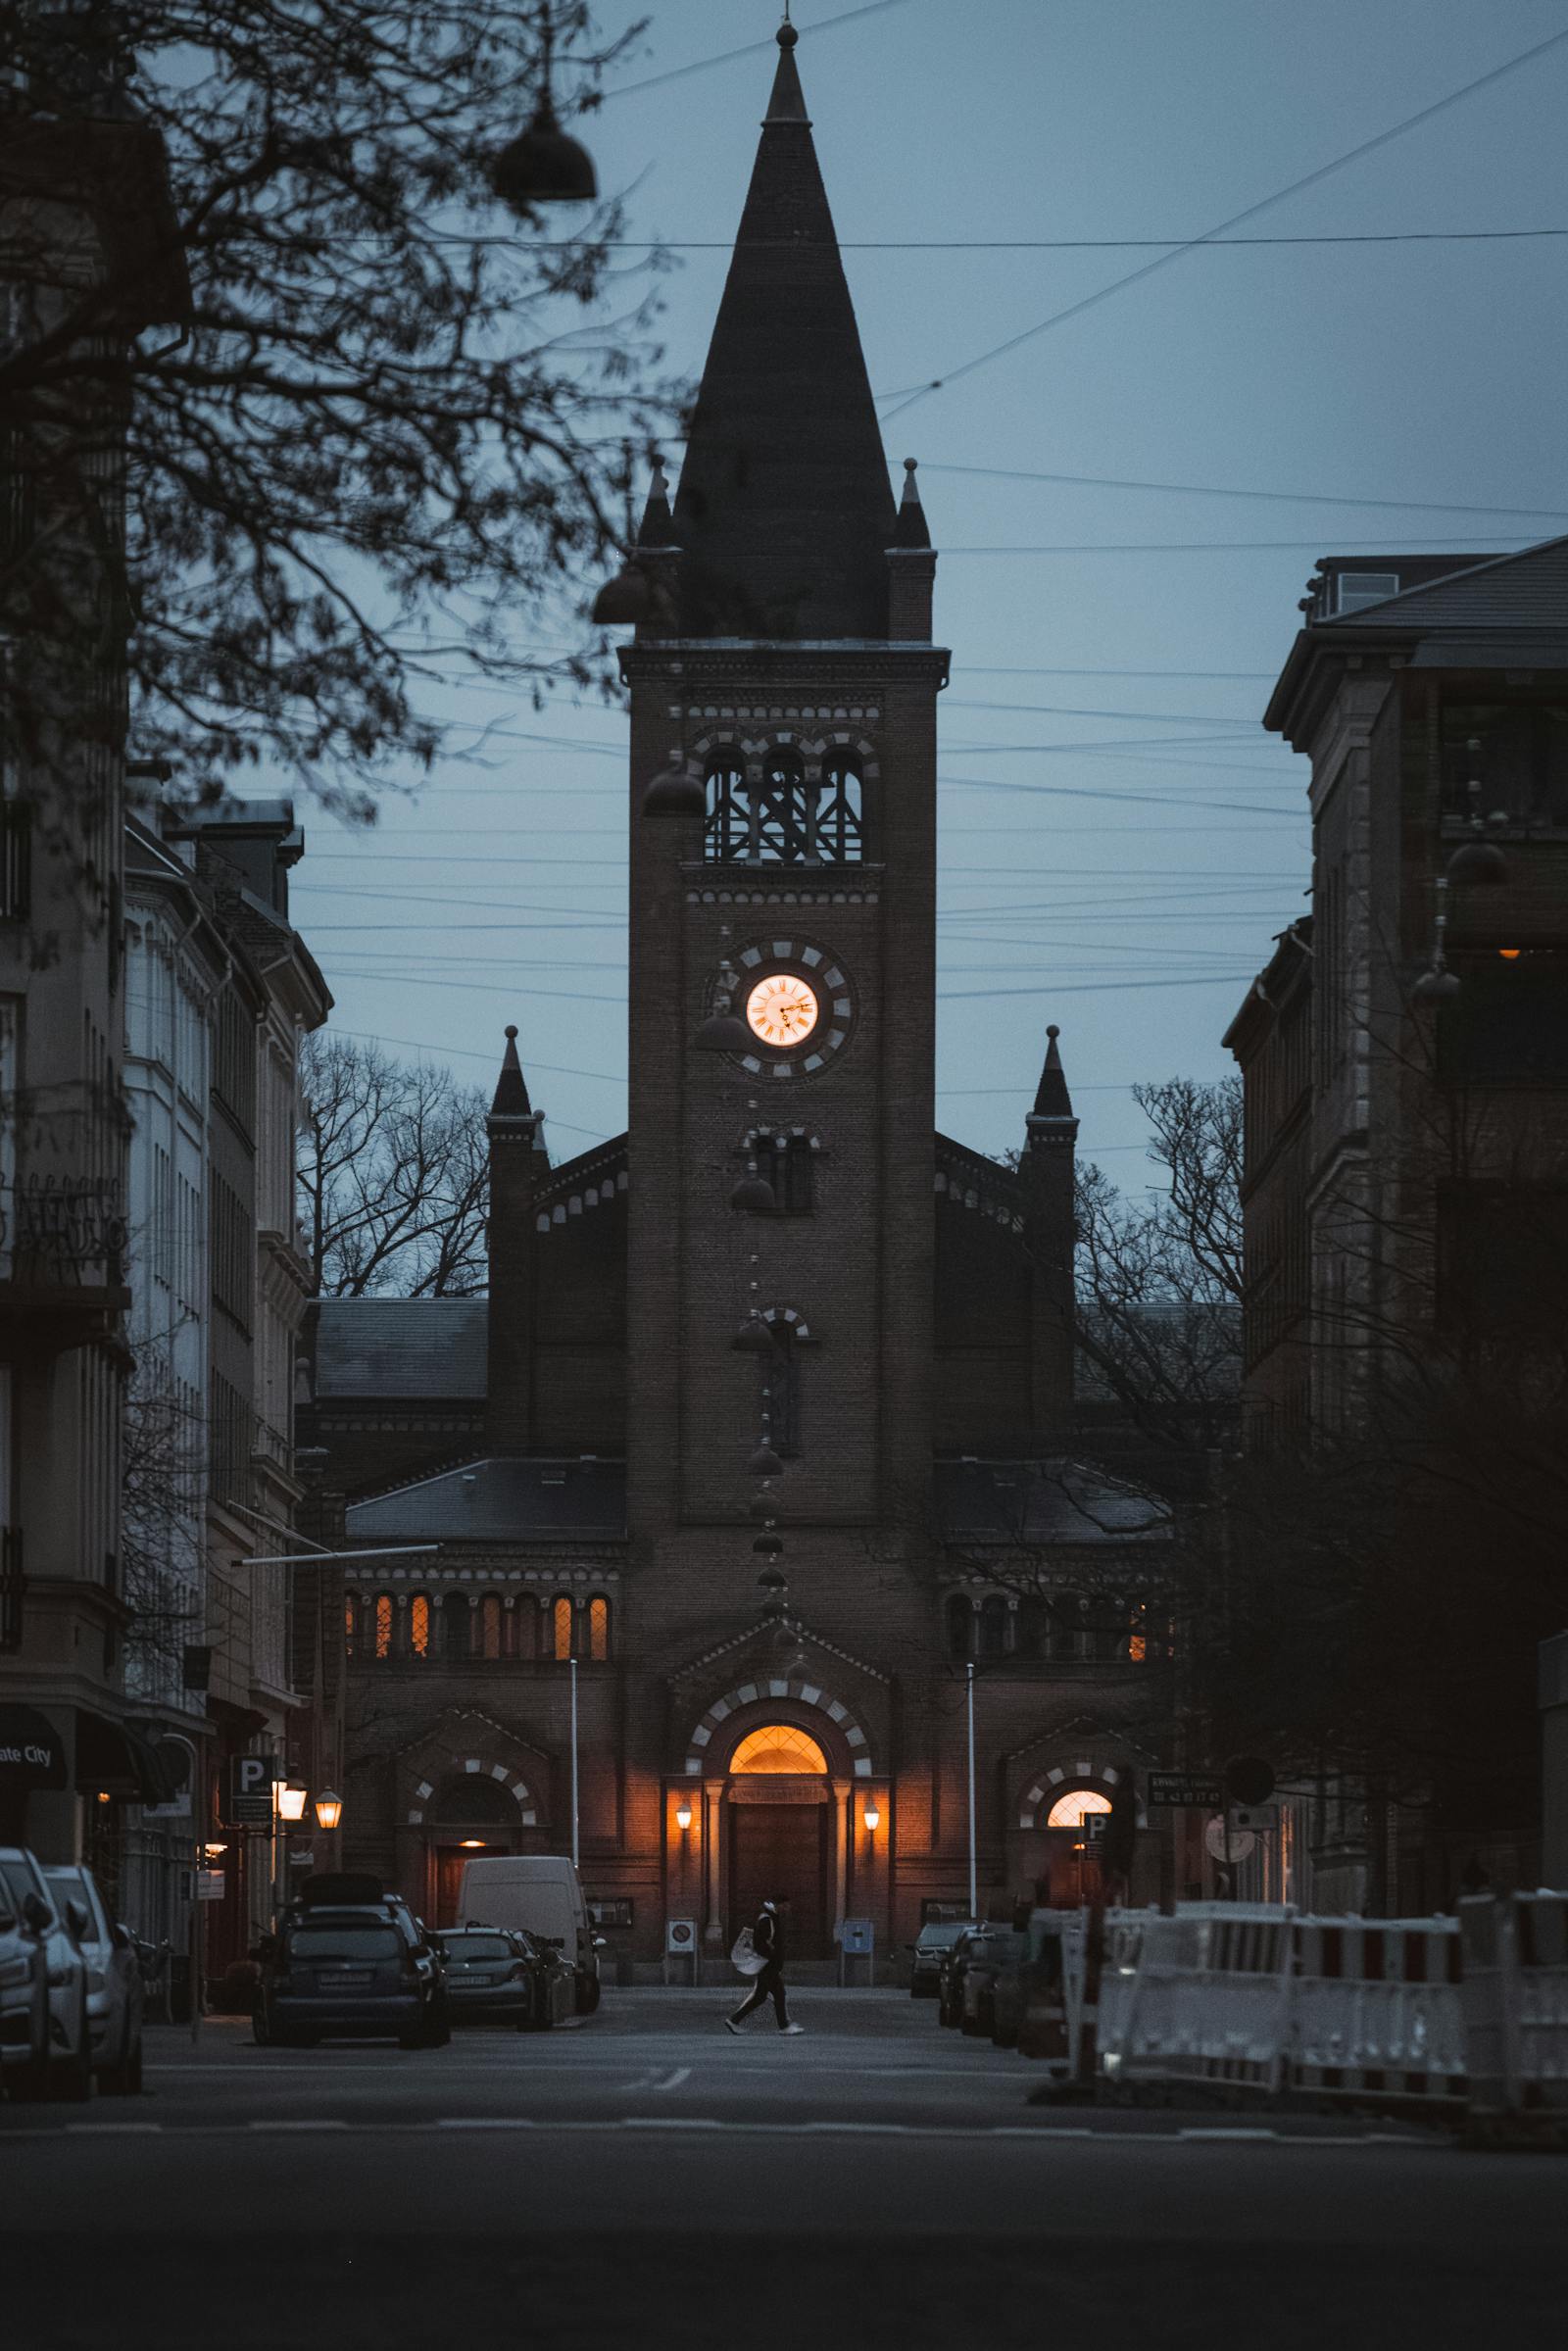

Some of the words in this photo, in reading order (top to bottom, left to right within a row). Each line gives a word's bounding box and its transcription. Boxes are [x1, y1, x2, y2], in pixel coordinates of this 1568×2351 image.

[24, 1745, 51, 1768] City
[241, 1760, 265, 1792] P
[1090, 1816, 1106, 1838] P
